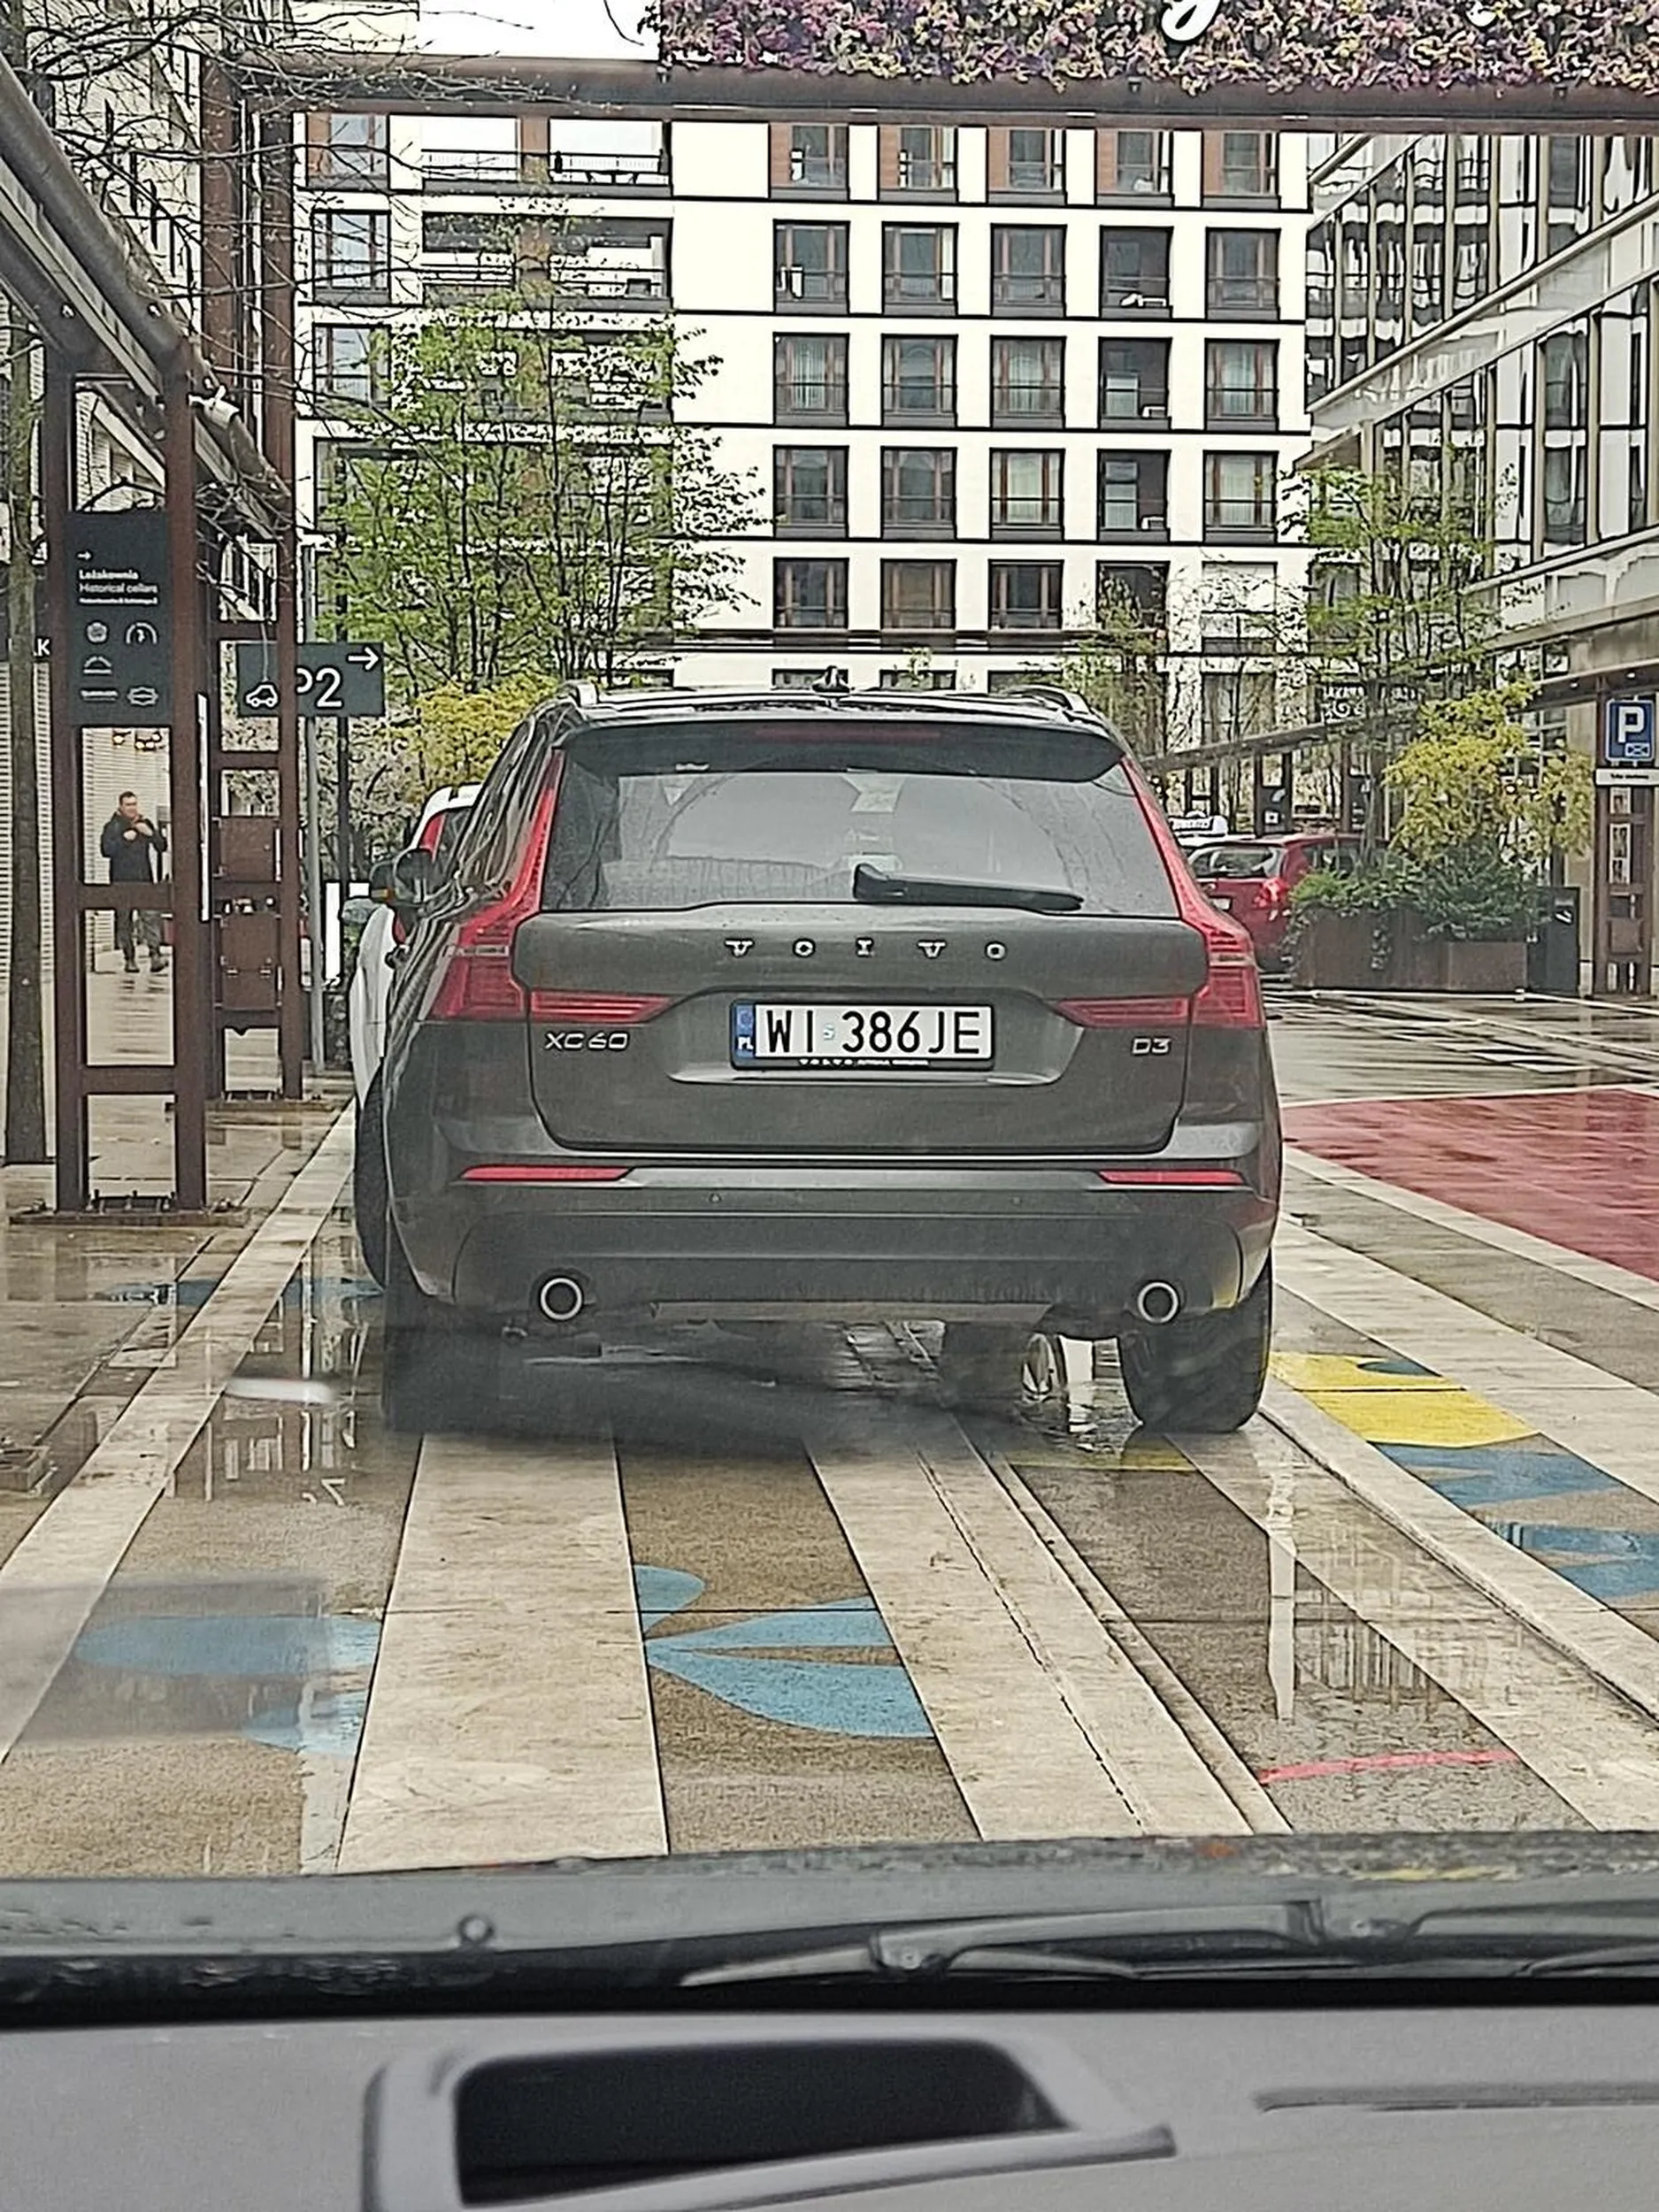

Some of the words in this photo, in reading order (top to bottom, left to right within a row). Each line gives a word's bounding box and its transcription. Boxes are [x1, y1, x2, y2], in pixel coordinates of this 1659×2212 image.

[1617, 706, 1645, 743] P
[738, 1036, 754, 1050] PL
[766, 1010, 813, 1053] WI
[841, 1010, 979, 1054] 386JE
[1133, 1038, 1171, 1054] D3
